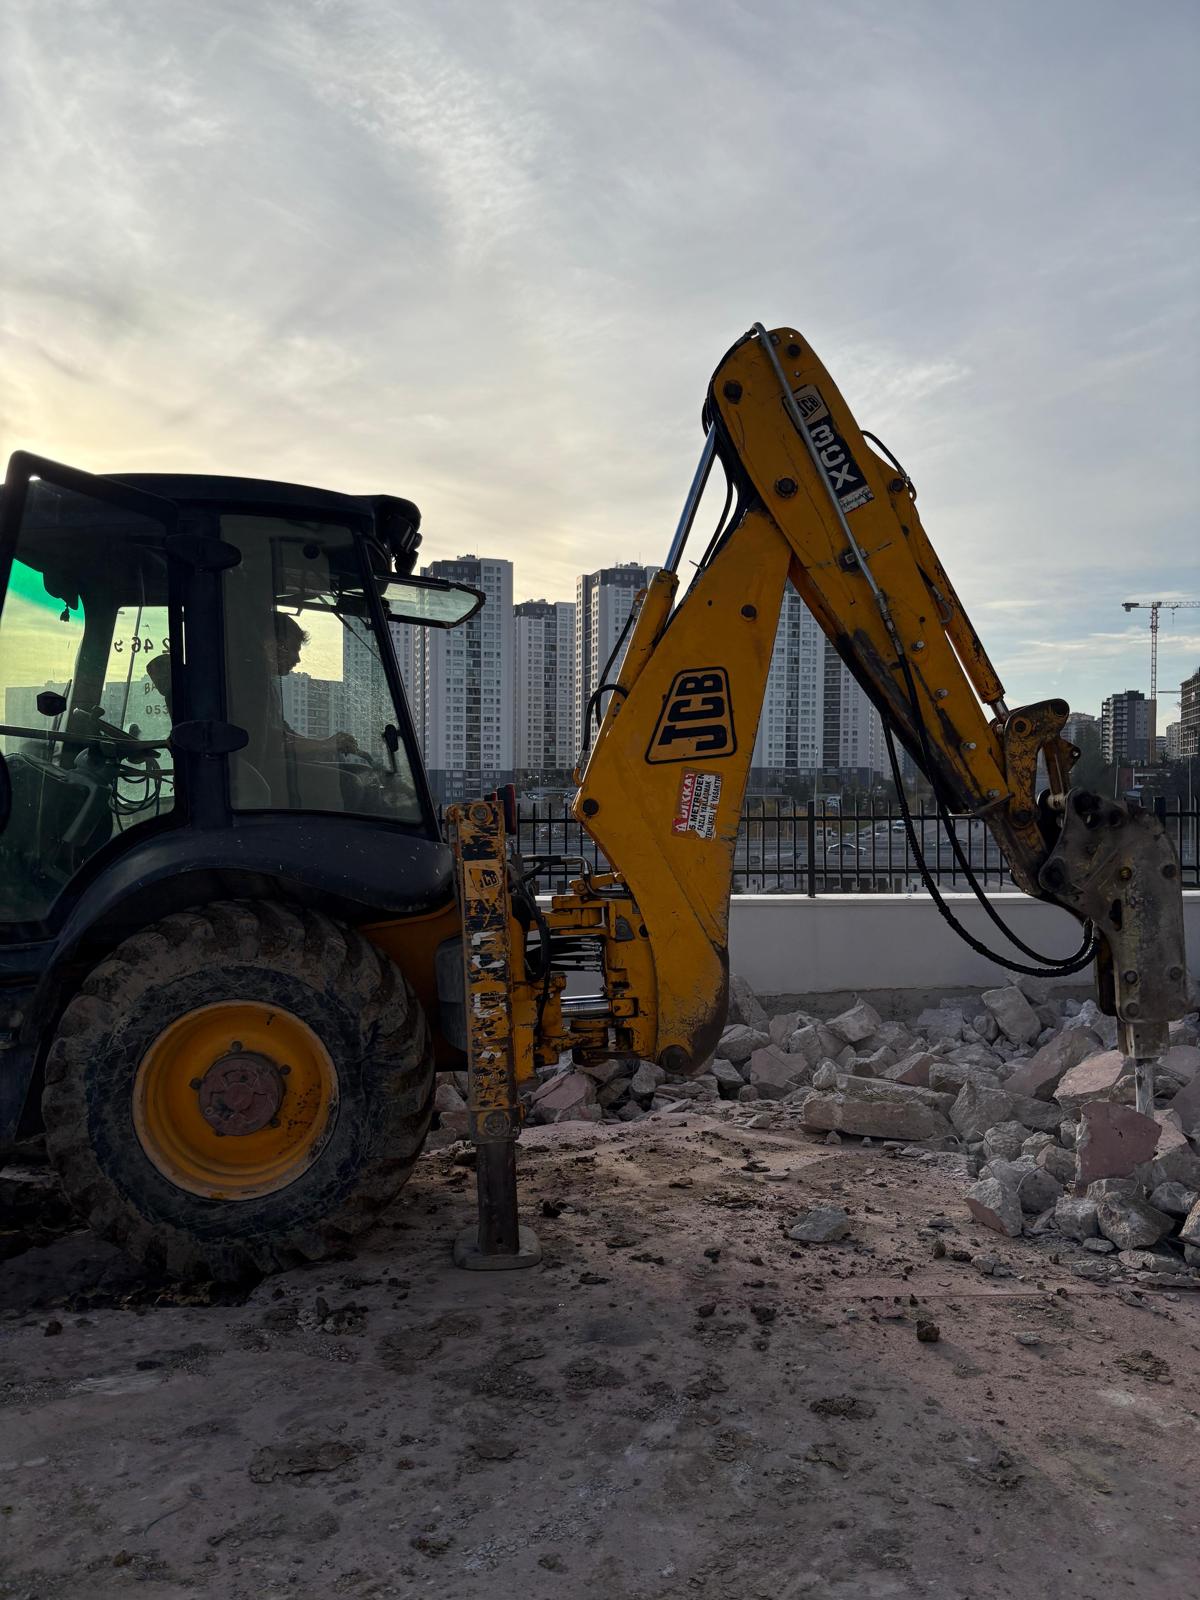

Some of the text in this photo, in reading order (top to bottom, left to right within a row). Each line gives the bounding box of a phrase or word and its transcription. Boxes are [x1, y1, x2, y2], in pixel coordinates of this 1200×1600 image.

[797, 397, 819, 417] JCB
[810, 424, 859, 490] 3CX
[657, 674, 727, 752] JCB
